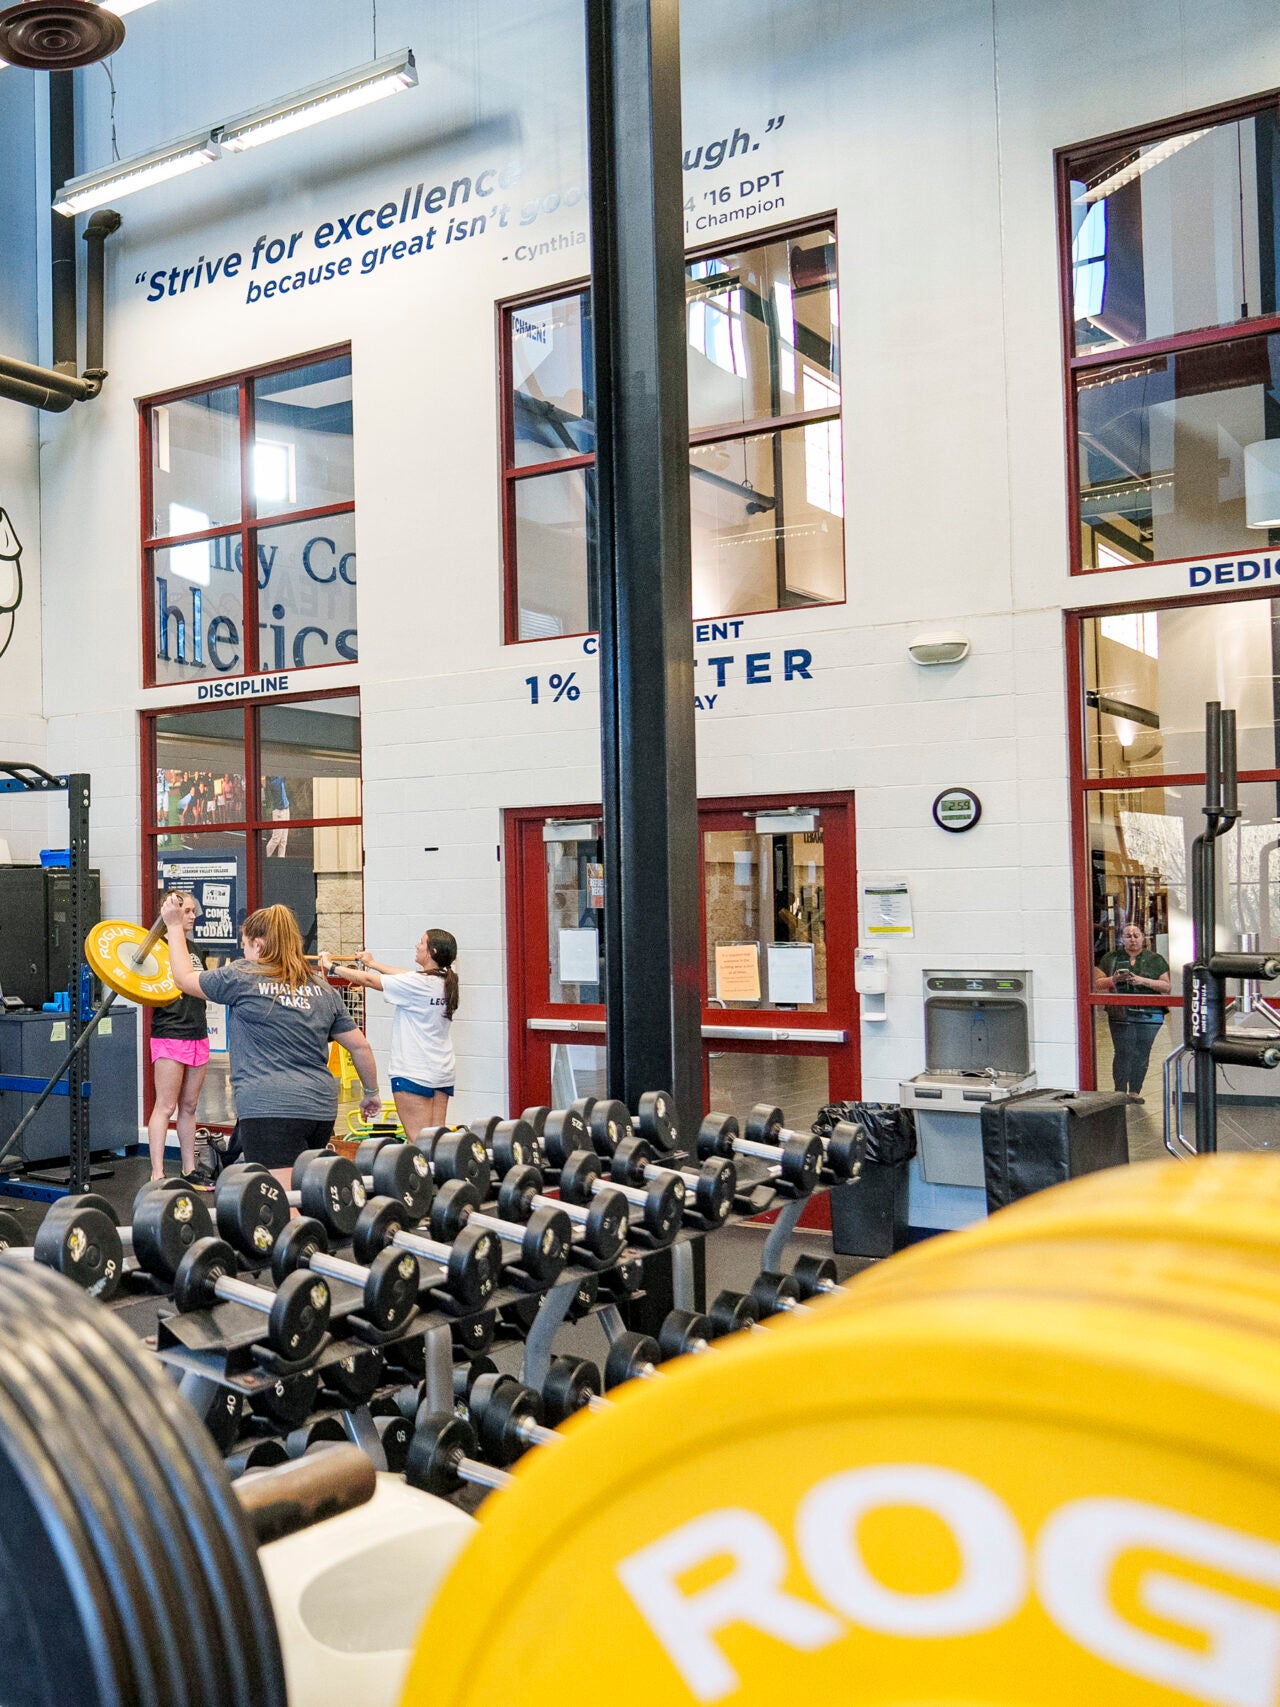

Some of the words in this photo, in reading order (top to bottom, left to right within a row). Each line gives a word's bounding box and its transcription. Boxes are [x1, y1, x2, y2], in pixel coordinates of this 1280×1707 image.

[739, 170, 784, 198] DPT
[251, 229, 303, 271] for
[314, 161, 521, 249] excellence
[695, 197, 785, 230] Champion
[246, 256, 352, 304] because
[360, 225, 437, 275] great
[518, 185, 589, 227] goo
[515, 230, 587, 262] Cynthia
[1188, 557, 1280, 588] DEDI
[198, 676, 289, 700] DISCIPLINE
[97, 927, 136, 960] ROGUE
[195, 922, 233, 938] TODAY!
[1192, 977, 1201, 1037] ROGUE
[260, 1182, 279, 1201] 27.5
[330, 1185, 341, 1212] 27.5
[104, 1259, 116, 1280] 30
[387, 1308, 396, 1322] 5
[290, 1334, 300, 1348] 5
[473, 1323, 484, 1338] 35
[226, 1394, 237, 1416] 40
